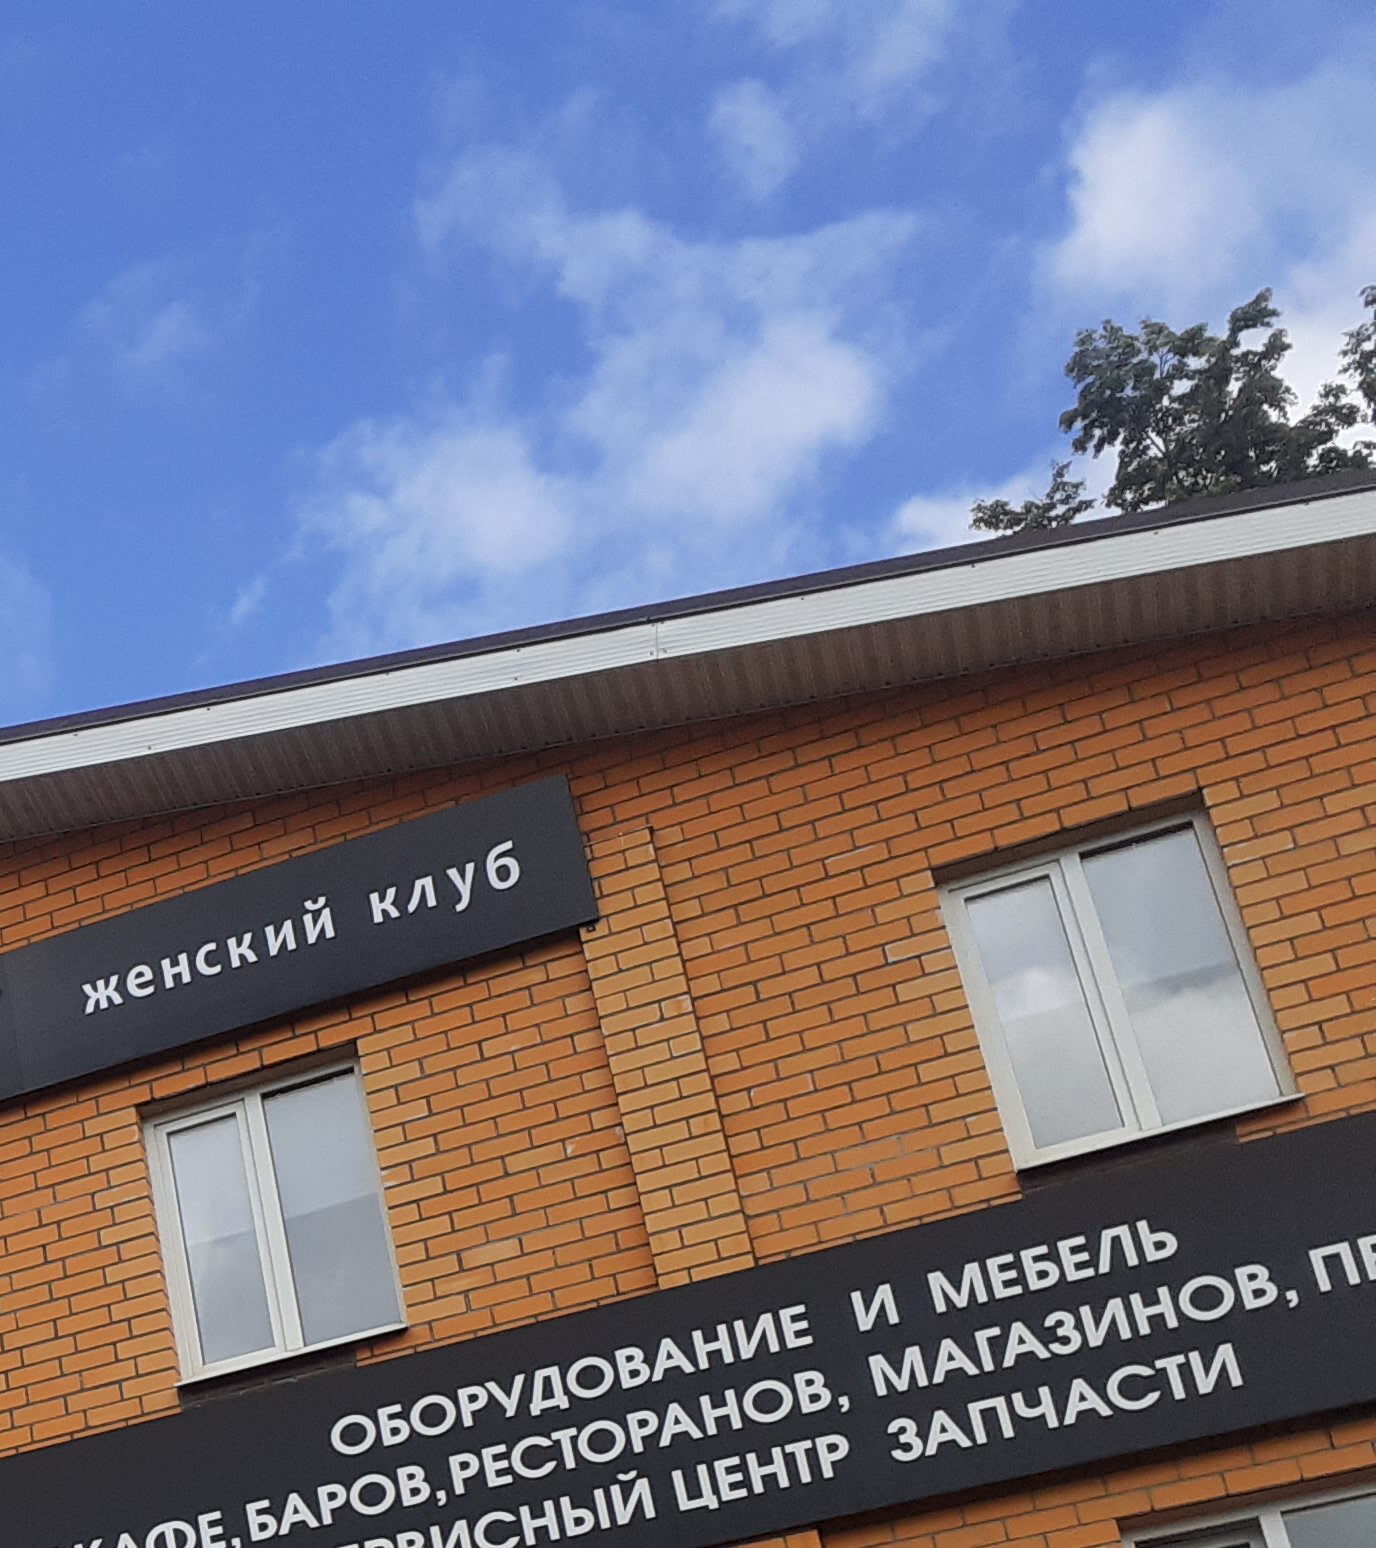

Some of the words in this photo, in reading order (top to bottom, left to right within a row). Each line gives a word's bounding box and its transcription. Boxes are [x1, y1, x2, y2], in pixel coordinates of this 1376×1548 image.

[82, 896, 336, 1016] женский
[369, 840, 521, 925] клуб
[245, 1463, 448, 1543] БАРОВ,
[449, 1369, 850, 1495] РЕСТОРАНОВ,
[867, 1263, 1299, 1404] МАГАЗИНОВ,
[330, 1302, 813, 1456] ОБОРУДОВАНИЕ
[851, 1280, 900, 1334] И
[926, 1218, 1179, 1319] МЕБЕЛЬ
[672, 1433, 849, 1512] ЦЕНТР
[887, 1343, 1245, 1463] ЗАПЧАСТИ
